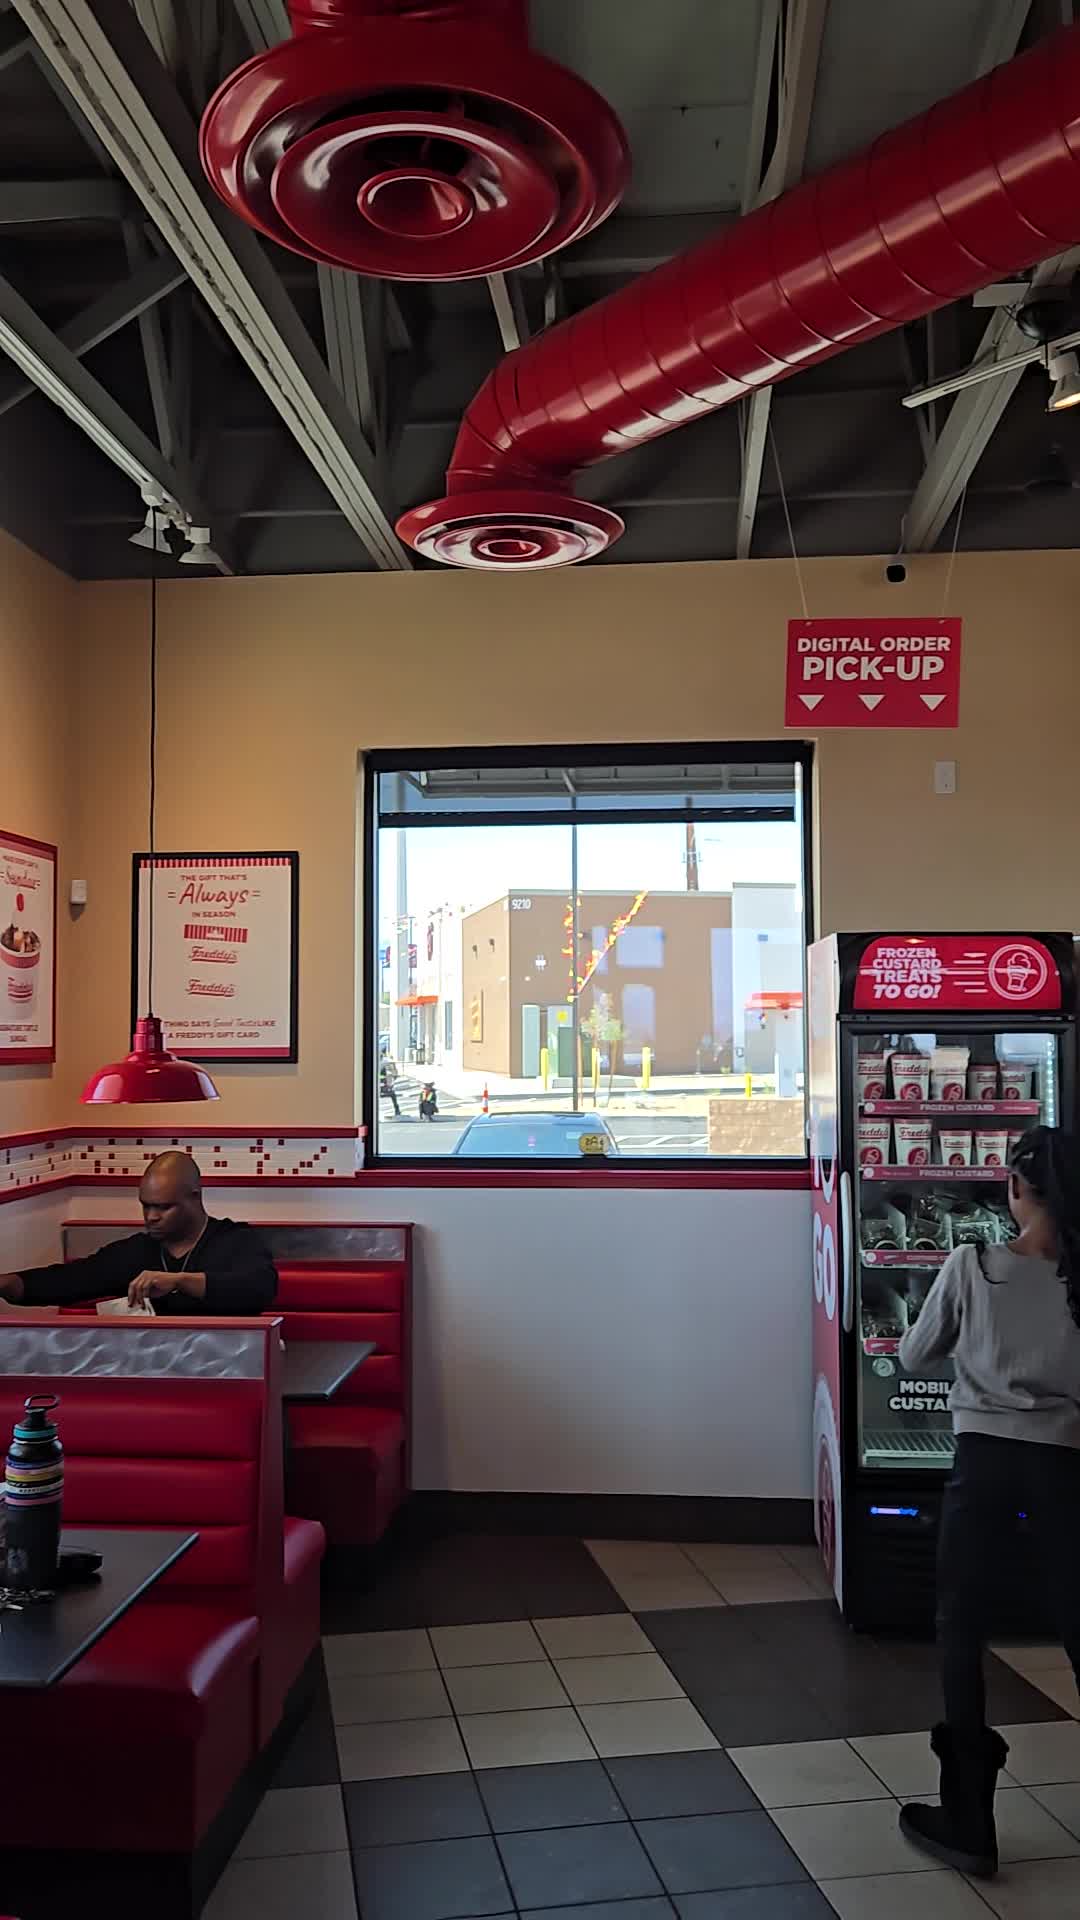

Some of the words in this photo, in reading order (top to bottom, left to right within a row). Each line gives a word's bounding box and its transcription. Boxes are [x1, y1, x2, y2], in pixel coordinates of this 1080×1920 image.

[797, 637, 875, 653] DIGITAL
[880, 636, 951, 652] ORDER
[802, 655, 945, 681] PICK-UP
[179, 882, 249, 909] Always
[511, 898, 532, 910] 9210
[202, 910, 236, 918] SEASON
[877, 947, 936, 958] FROZEN
[872, 959, 941, 970] CUSTARD
[874, 969, 942, 983] TREATS
[873, 985, 900, 999] TO
[903, 984, 941, 999] GO!
[175, 1031, 214, 1039] FREDDY'S
[919, 1104, 954, 1112] FROZEN
[956, 1104, 995, 1112] CUSTARD
[919, 1169, 954, 1178] FROZEN
[899, 1381, 953, 1394] MOBIL
